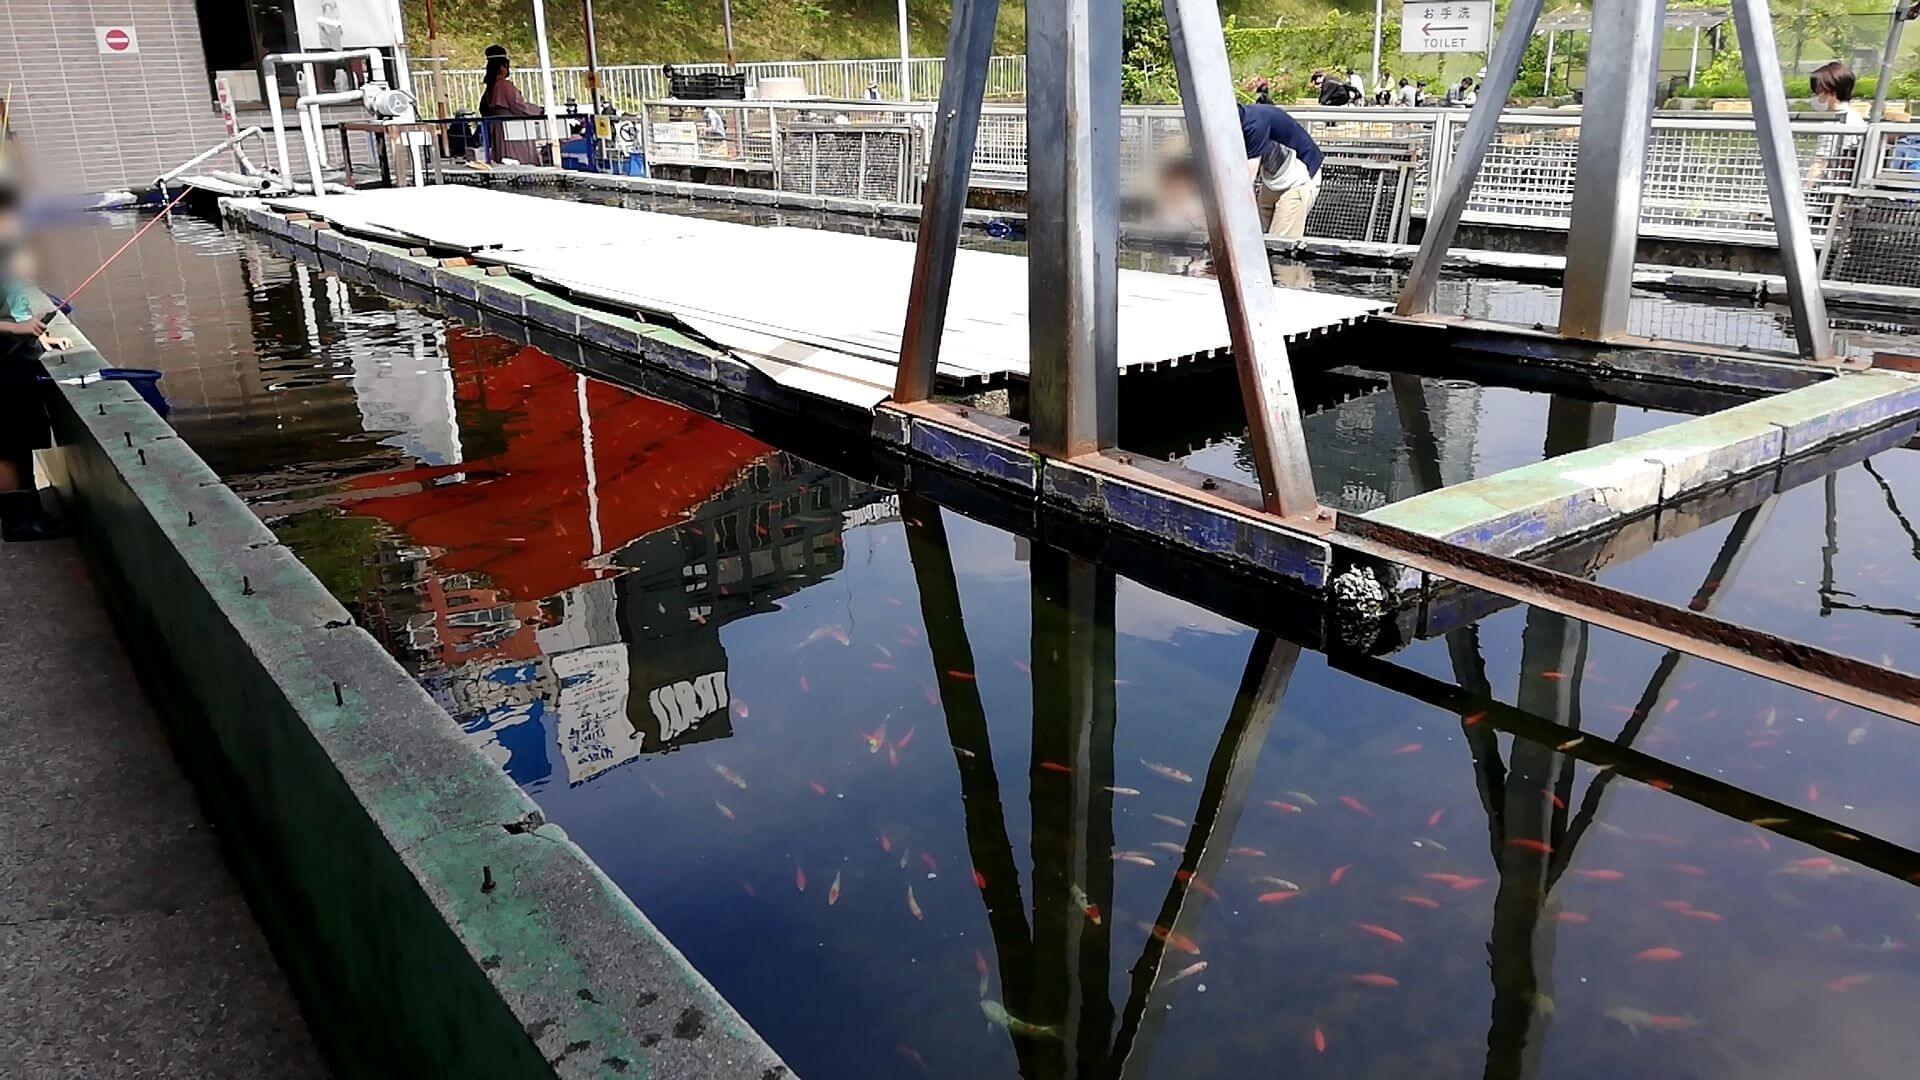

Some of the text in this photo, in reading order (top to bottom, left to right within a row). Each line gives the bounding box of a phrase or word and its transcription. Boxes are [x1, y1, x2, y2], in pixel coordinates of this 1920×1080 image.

[1423, 6, 1471, 20] お手洗
[1423, 38, 1467, 48] TOILET
